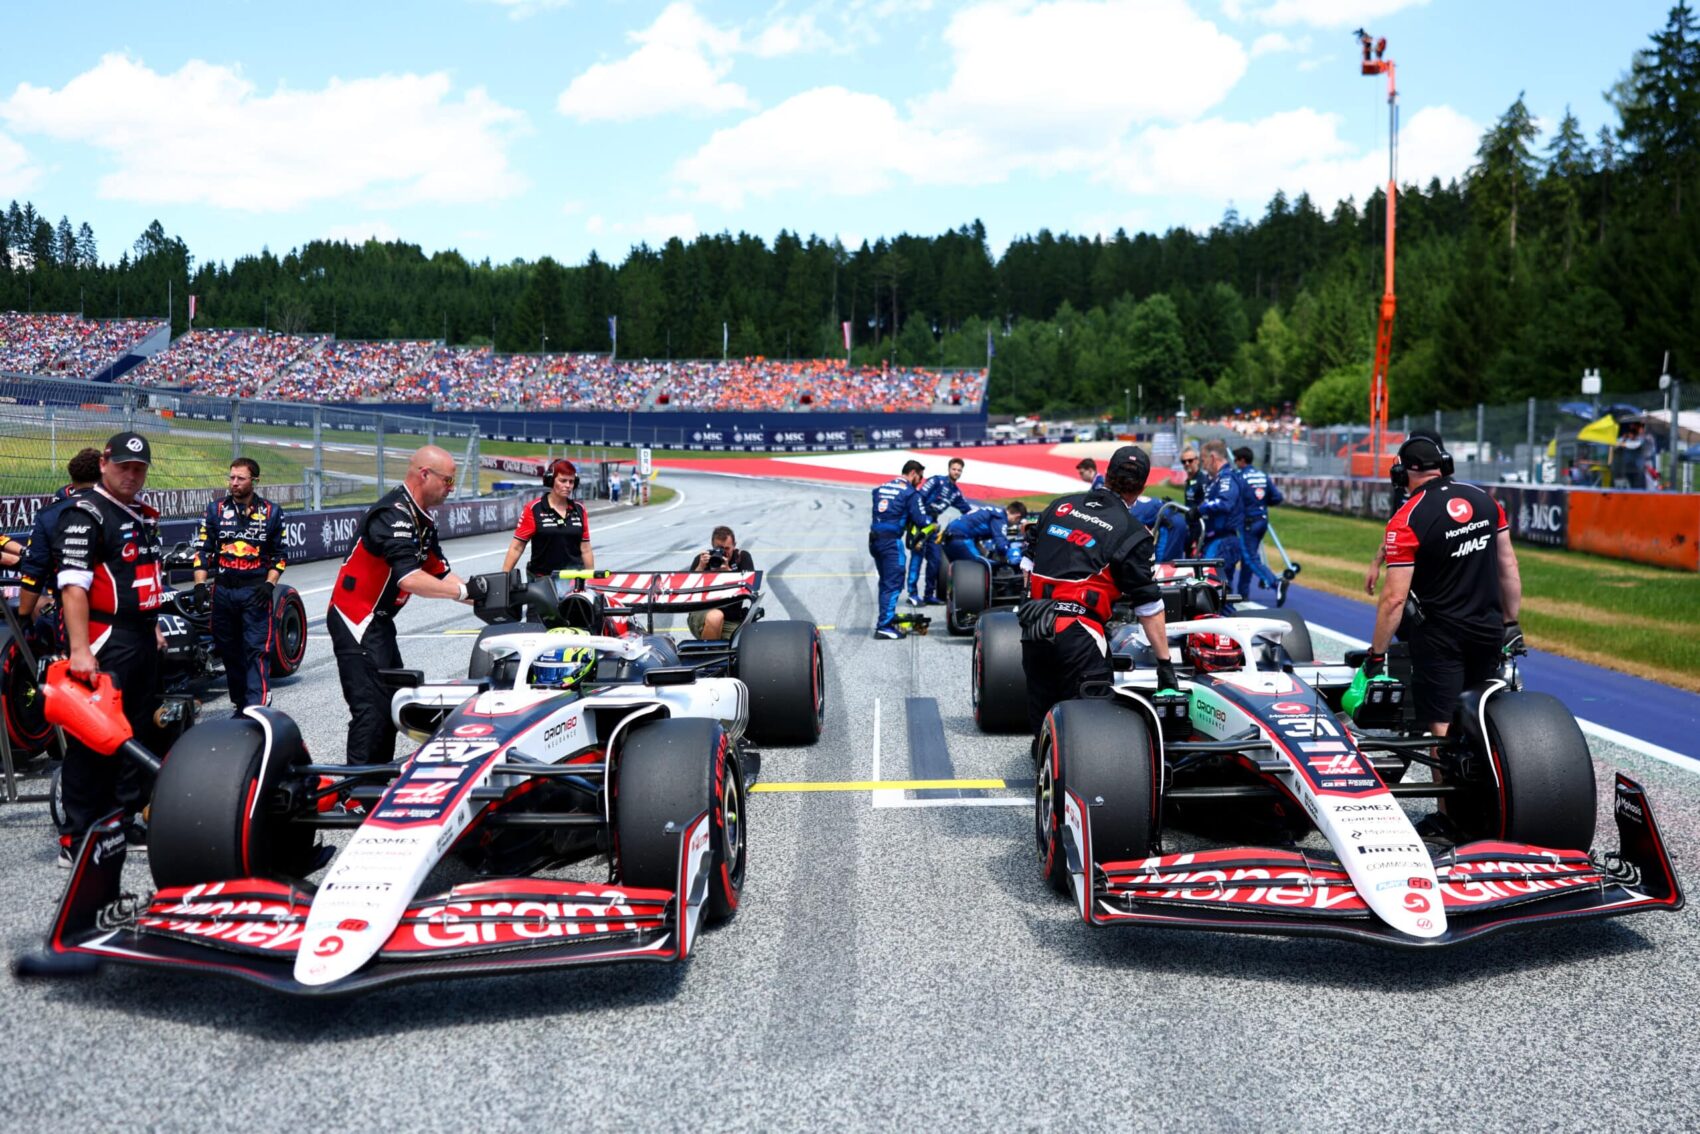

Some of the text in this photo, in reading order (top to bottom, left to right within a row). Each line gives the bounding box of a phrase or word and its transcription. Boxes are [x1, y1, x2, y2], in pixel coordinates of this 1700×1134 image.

[142, 492, 178, 516] QATAR
[1069, 508, 1114, 531] MoneyGram
[1531, 503, 1562, 531] MSC
[219, 530, 267, 541] ORACLE
[1445, 519, 1490, 539] MoneyGram
[1451, 534, 1491, 557] HAAS
[1277, 718, 1340, 737] 31
[416, 742, 500, 763] 87
[1125, 852, 1358, 909] Money
[1435, 851, 1590, 901] Gram
[413, 890, 638, 947] Gram
